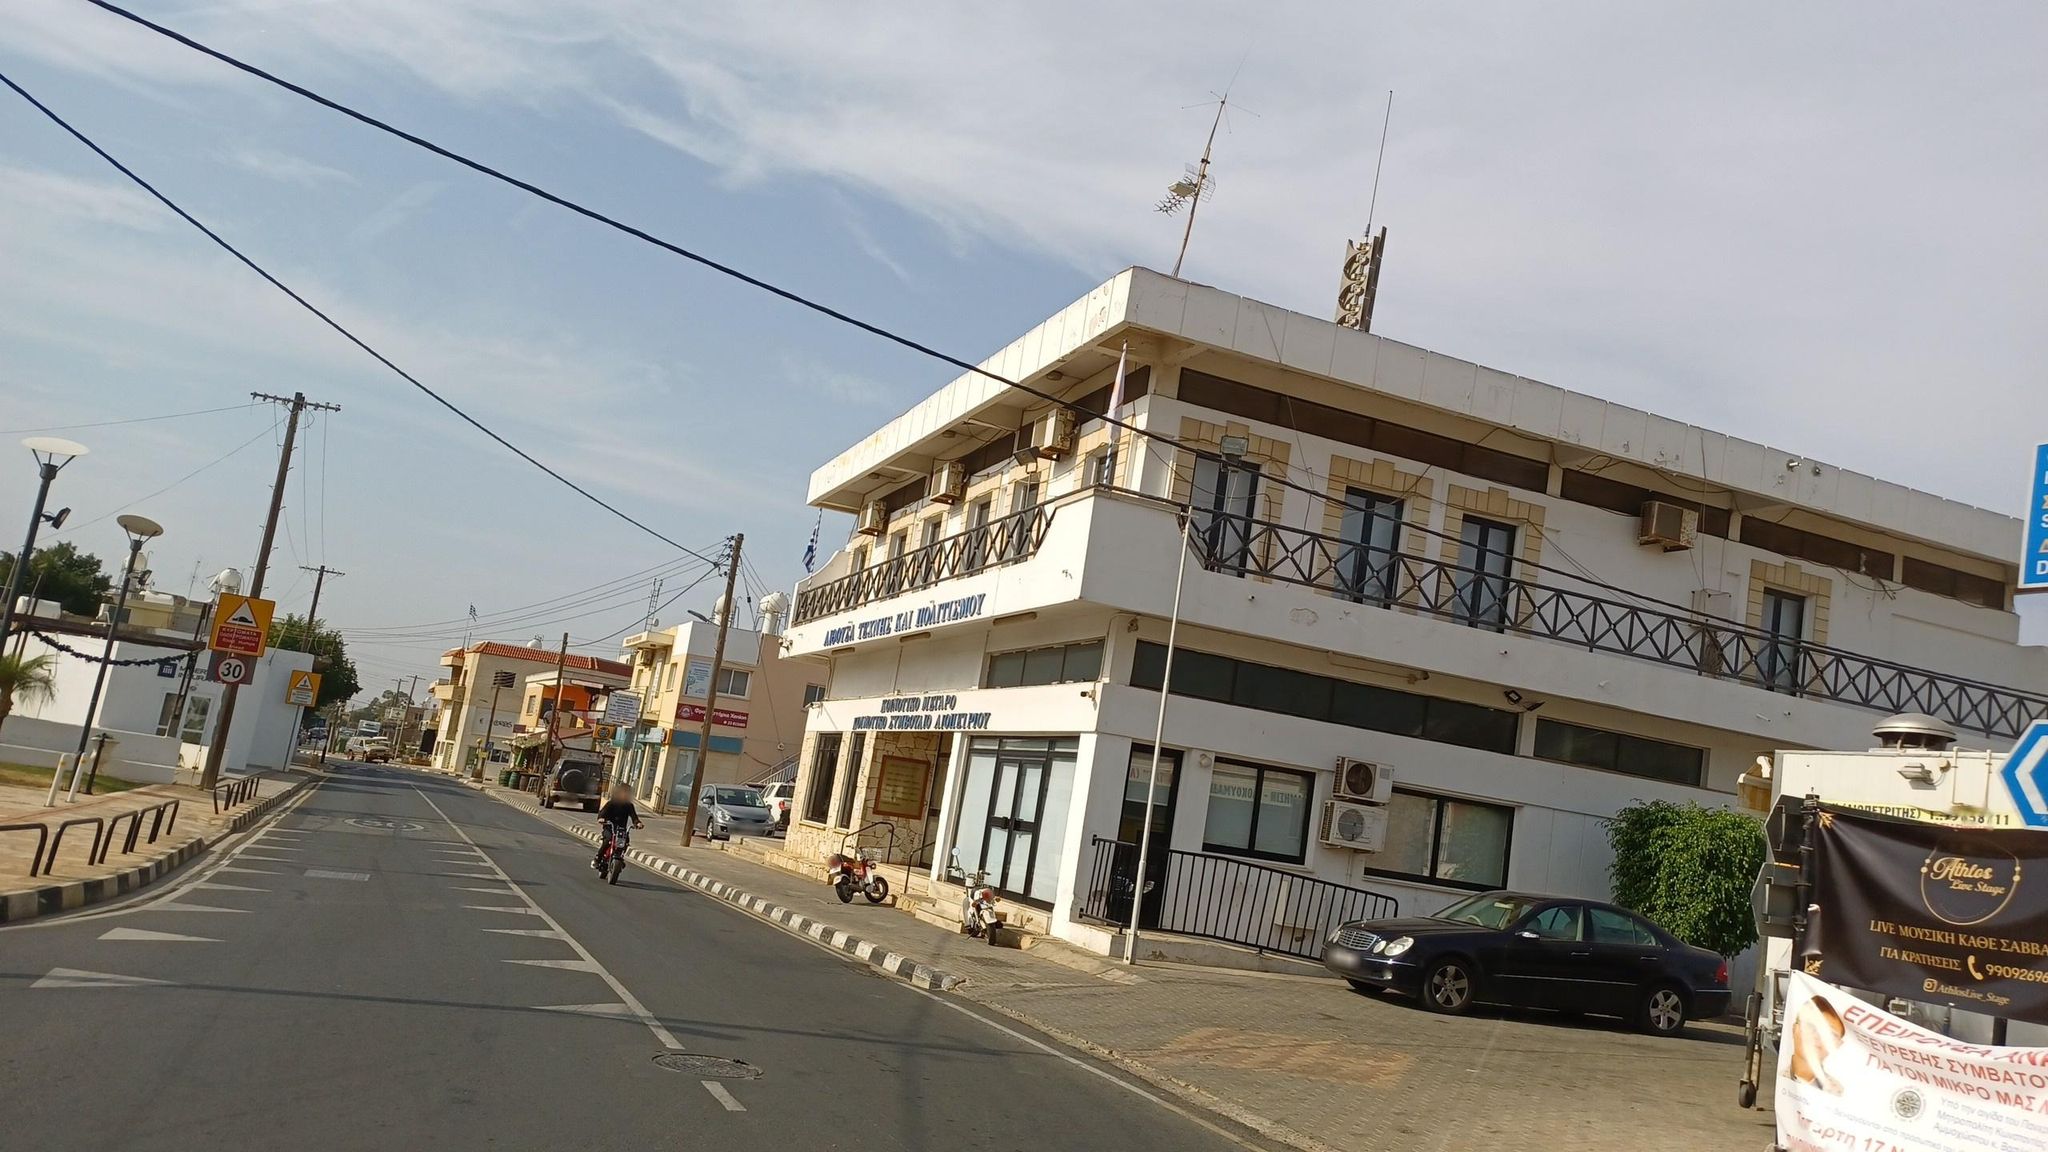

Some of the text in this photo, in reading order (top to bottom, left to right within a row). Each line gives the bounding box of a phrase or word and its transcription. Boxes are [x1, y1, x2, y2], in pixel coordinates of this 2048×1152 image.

[858, 615, 893, 640] ΤΕΧΝΗΣ
[895, 610, 914, 632] ΚΑΙ
[915, 593, 986, 628] ΠΟΛΙΤΙΣΜΟΥ
[221, 662, 242, 679] 30
[880, 694, 957, 713] ΚΟΙΝΟΤΙΚΟ ΜΕΓΑΡΟ
[888, 714, 932, 730] ΣΥΜΒΟΥΛΙΟ
[934, 712, 991, 730] ΛΙΟΠΕΤΡΙΟΥ
[1930, 857, 1993, 881] Athlos
[1974, 881, 2007, 896] Stage
[1869, 920, 1896, 935] LIVE
[1898, 924, 1955, 945] ΜΟΥΣΙΚΗ
[1958, 933, 1998, 950] ΚΑΘΕ
[1880, 946, 1899, 959] ΓΙΑ
[1901, 950, 1962, 971] ΚΡΑΤΗΣΕΙΣ
[1866, 1053, 1893, 1074] ΓΙΑ
[1894, 1063, 1930, 1085] ΤΟΝ
[1932, 1074, 1990, 1100] ΜΙΚΡΟ
[1995, 1090, 2036, 1111] ΜΑΣ
